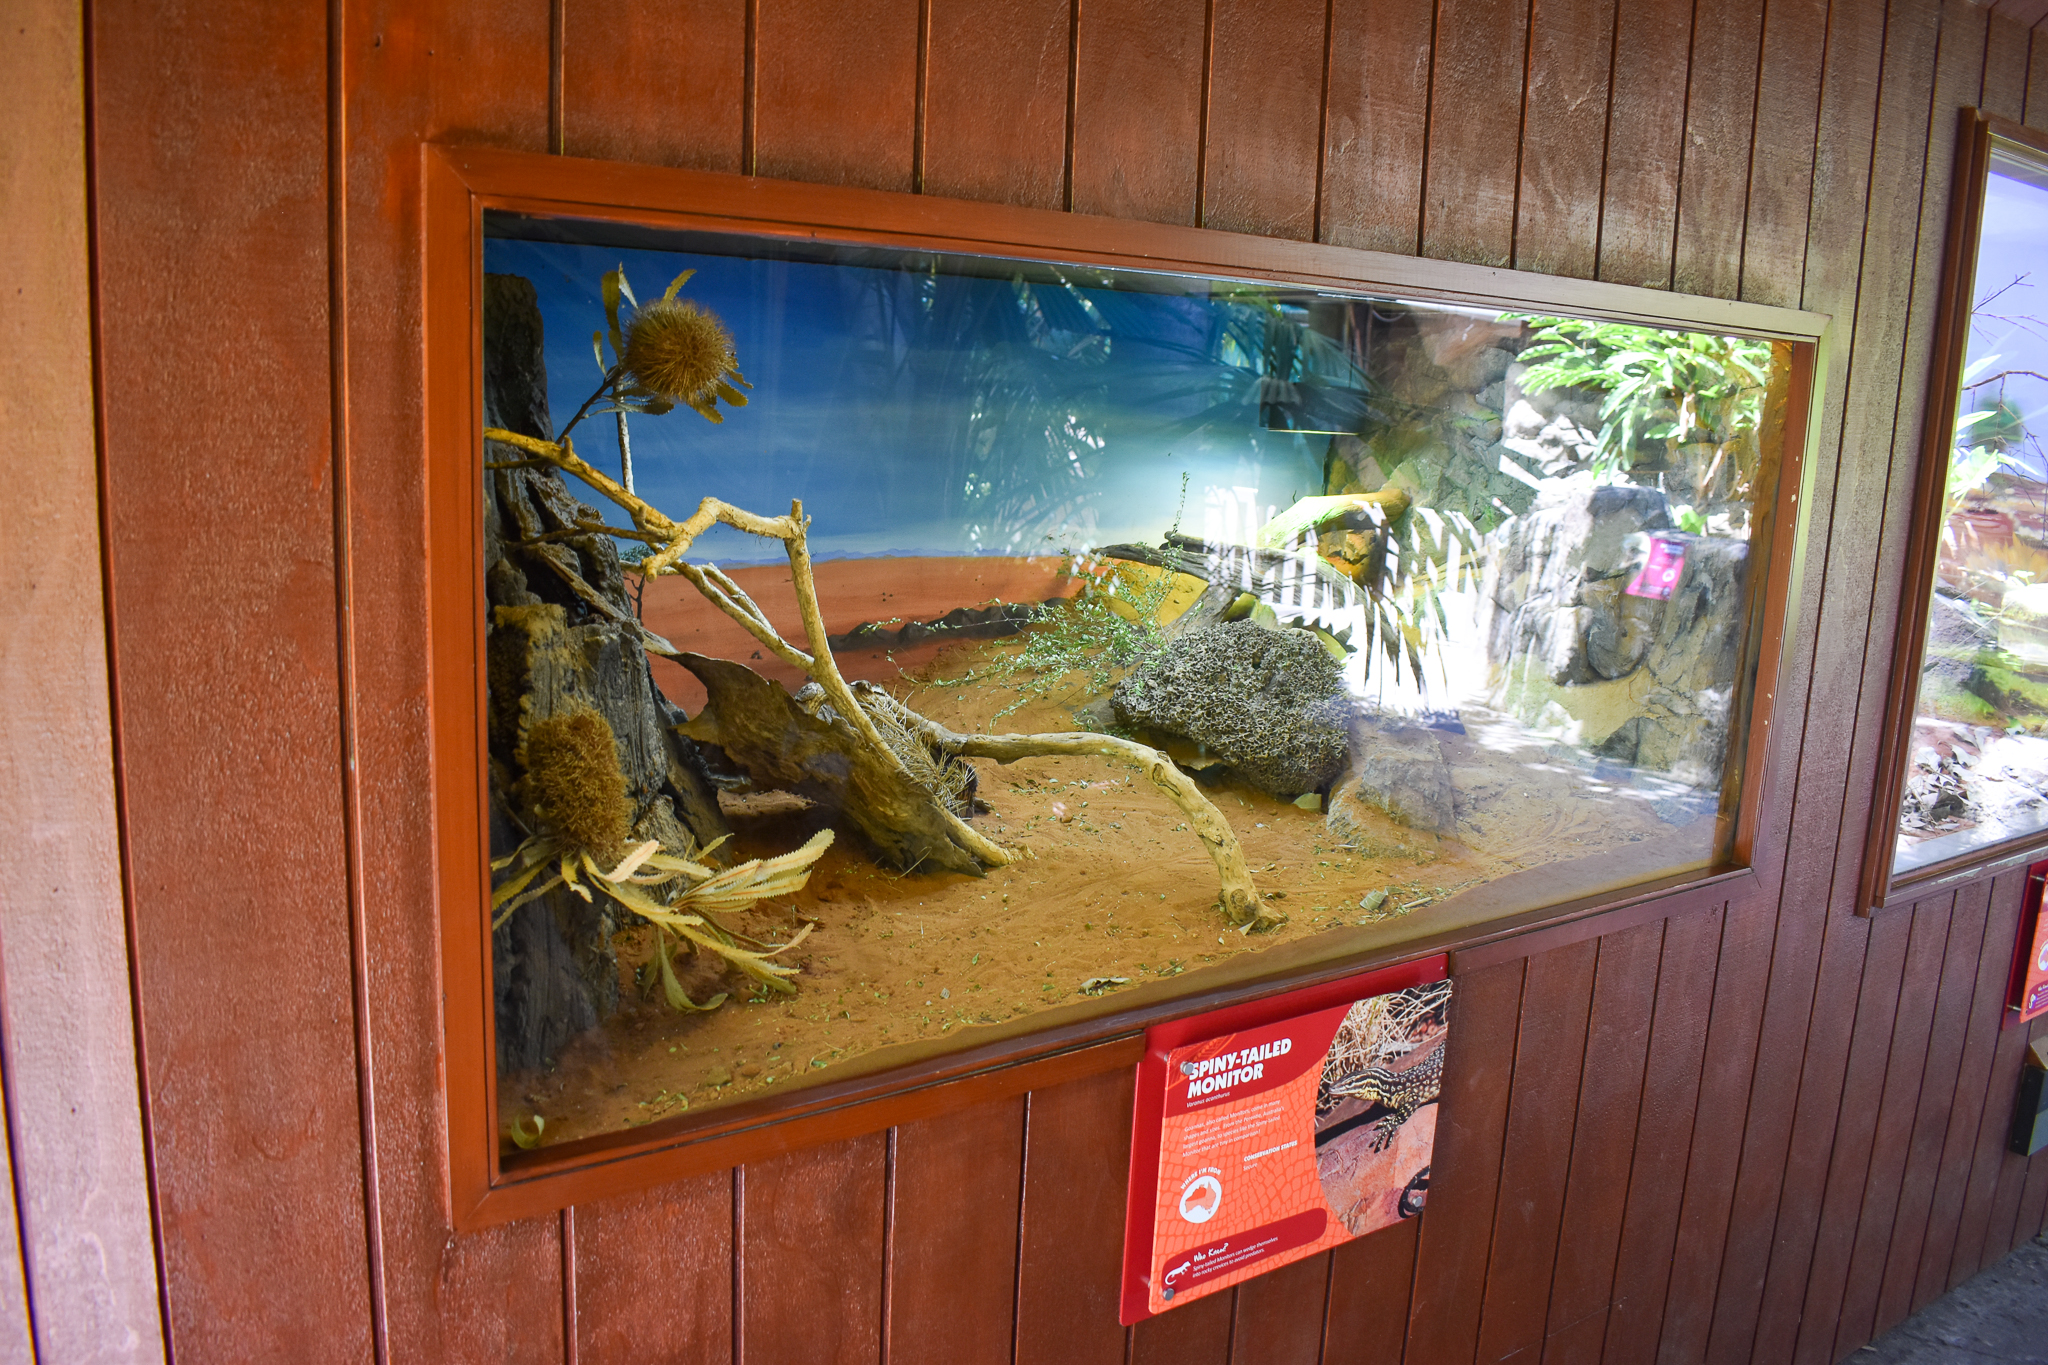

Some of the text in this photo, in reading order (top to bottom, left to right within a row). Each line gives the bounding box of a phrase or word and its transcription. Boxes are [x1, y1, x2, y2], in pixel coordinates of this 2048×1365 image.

[1189, 1038, 1292, 1081] SPINY-TAILED
[1187, 1063, 1264, 1099] MONITOR
[1186, 1091, 1230, 1108] Varanus acanthurus
[1183, 1141, 1198, 1149] largest
[1223, 1129, 1239, 1138] species
[1256, 1115, 1280, 1128] Spiny-tailed
[1184, 1123, 1205, 1132] Goannas,
[1216, 1114, 1229, 1123] called
[1230, 1108, 1250, 1119] Monitors,
[1184, 1132, 1200, 1141] shapes
[1223, 1121, 1234, 1129] From
[1263, 1106, 1284, 1116] Australia's
[1182, 1148, 1200, 1157] Monitor
[1233, 1129, 1260, 1142] comparison!
[1244, 1146, 1280, 1162] CONSERVATION
[1180, 1166, 1222, 1190] WHERE I'M FROM
[1243, 1162, 1258, 1171] Secure
[1193, 1258, 1216, 1271] Spiny-tailed
[1217, 1253, 1235, 1262] Monitors
[1243, 1245, 1256, 1253] wedge
[1256, 1237, 1278, 1247] themselves
[1194, 1252, 1206, 1262] Who
[1202, 1267, 1212, 1275] rocky
[1213, 1261, 1229, 1270] crevices
[1234, 1254, 1245, 1262] avoid
